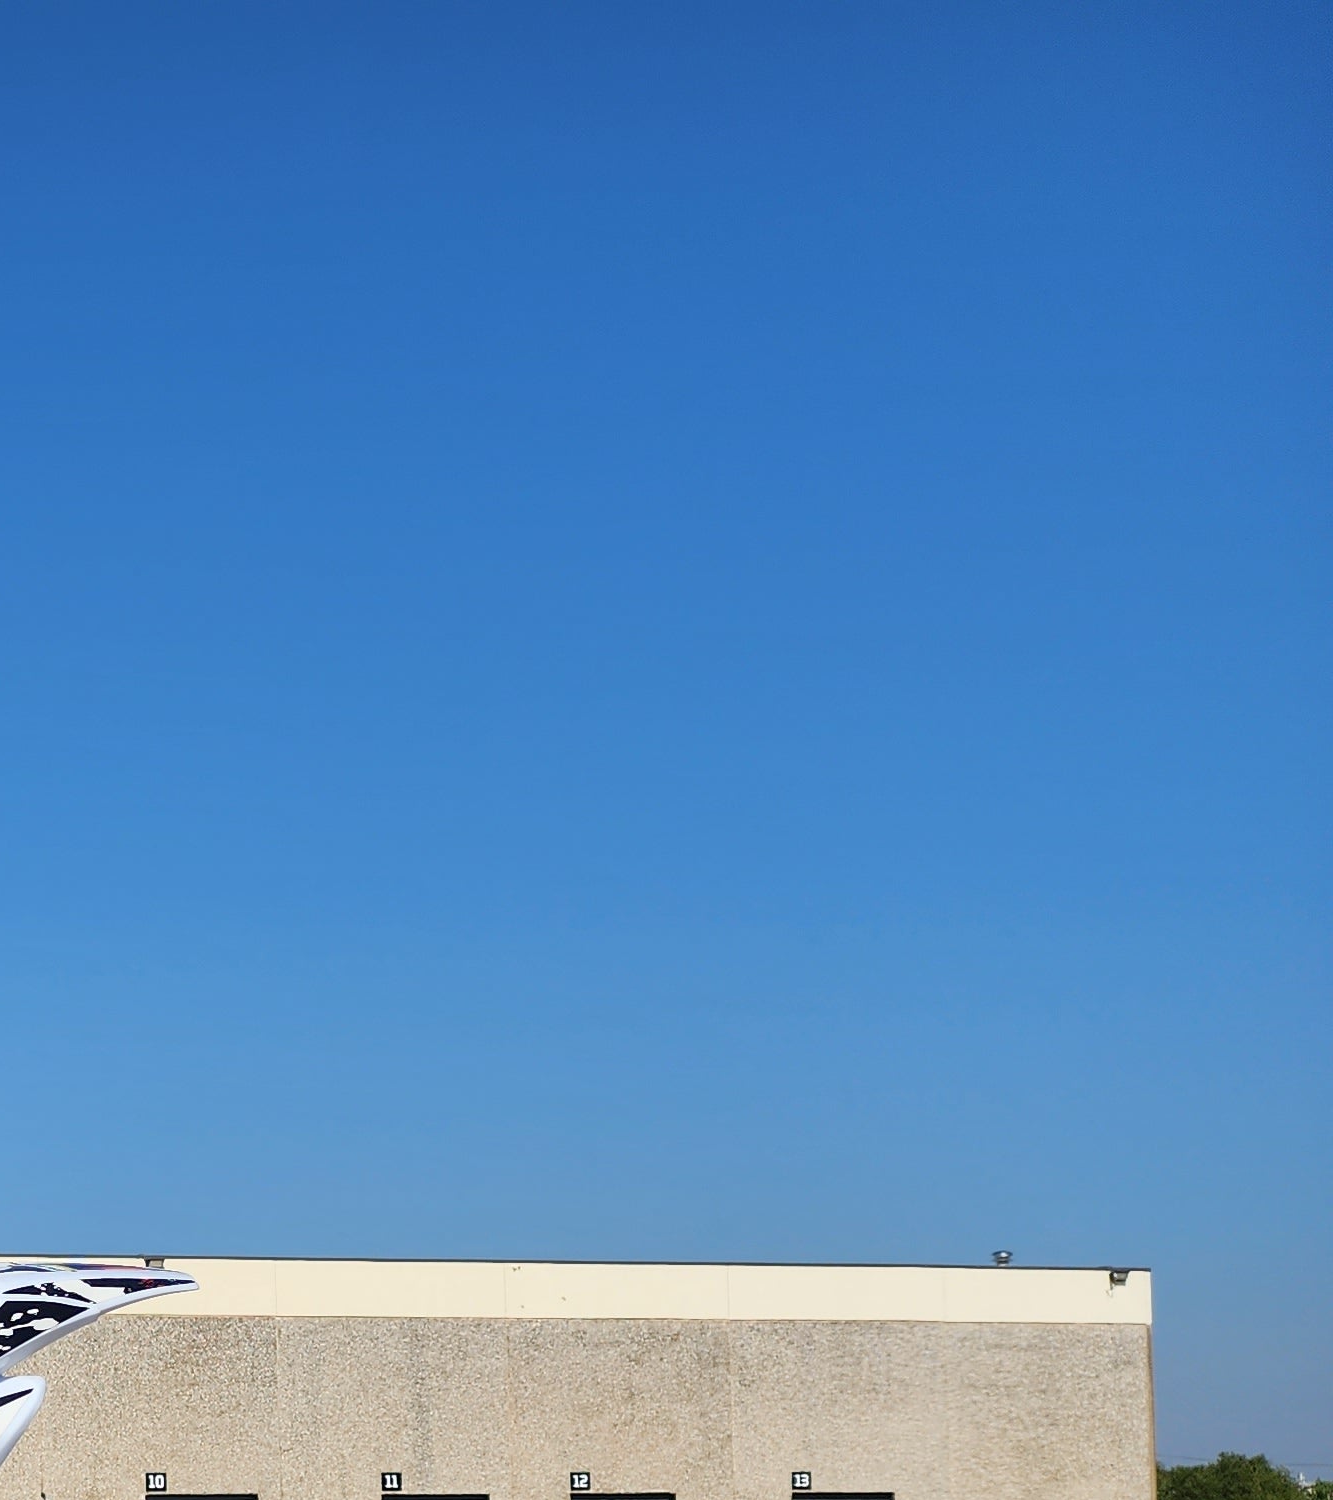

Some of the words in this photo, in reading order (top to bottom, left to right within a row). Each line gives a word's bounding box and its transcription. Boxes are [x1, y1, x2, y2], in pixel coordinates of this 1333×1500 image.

[148, 1474, 165, 1489] 10
[384, 1474, 399, 1489] 11
[572, 1474, 589, 1488] 12
[793, 1473, 810, 1488] 13
